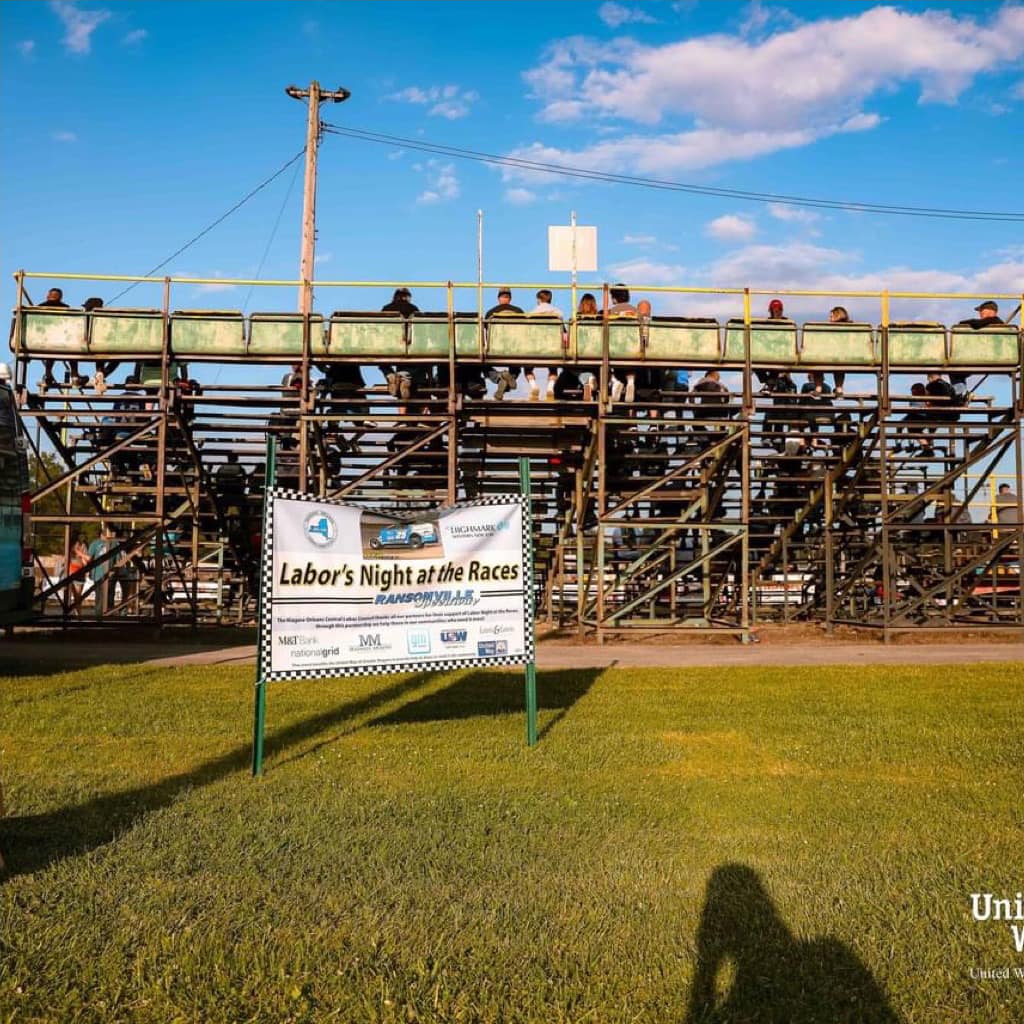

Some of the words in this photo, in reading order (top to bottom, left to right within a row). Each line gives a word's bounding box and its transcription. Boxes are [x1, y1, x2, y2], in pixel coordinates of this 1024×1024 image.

[280, 562, 354, 586] Labor's
[360, 563, 413, 592] Night
[417, 566, 436, 585] at
[437, 561, 464, 582] the
[468, 560, 519, 581] Races
[375, 590, 474, 605] RANSOMVILLE
